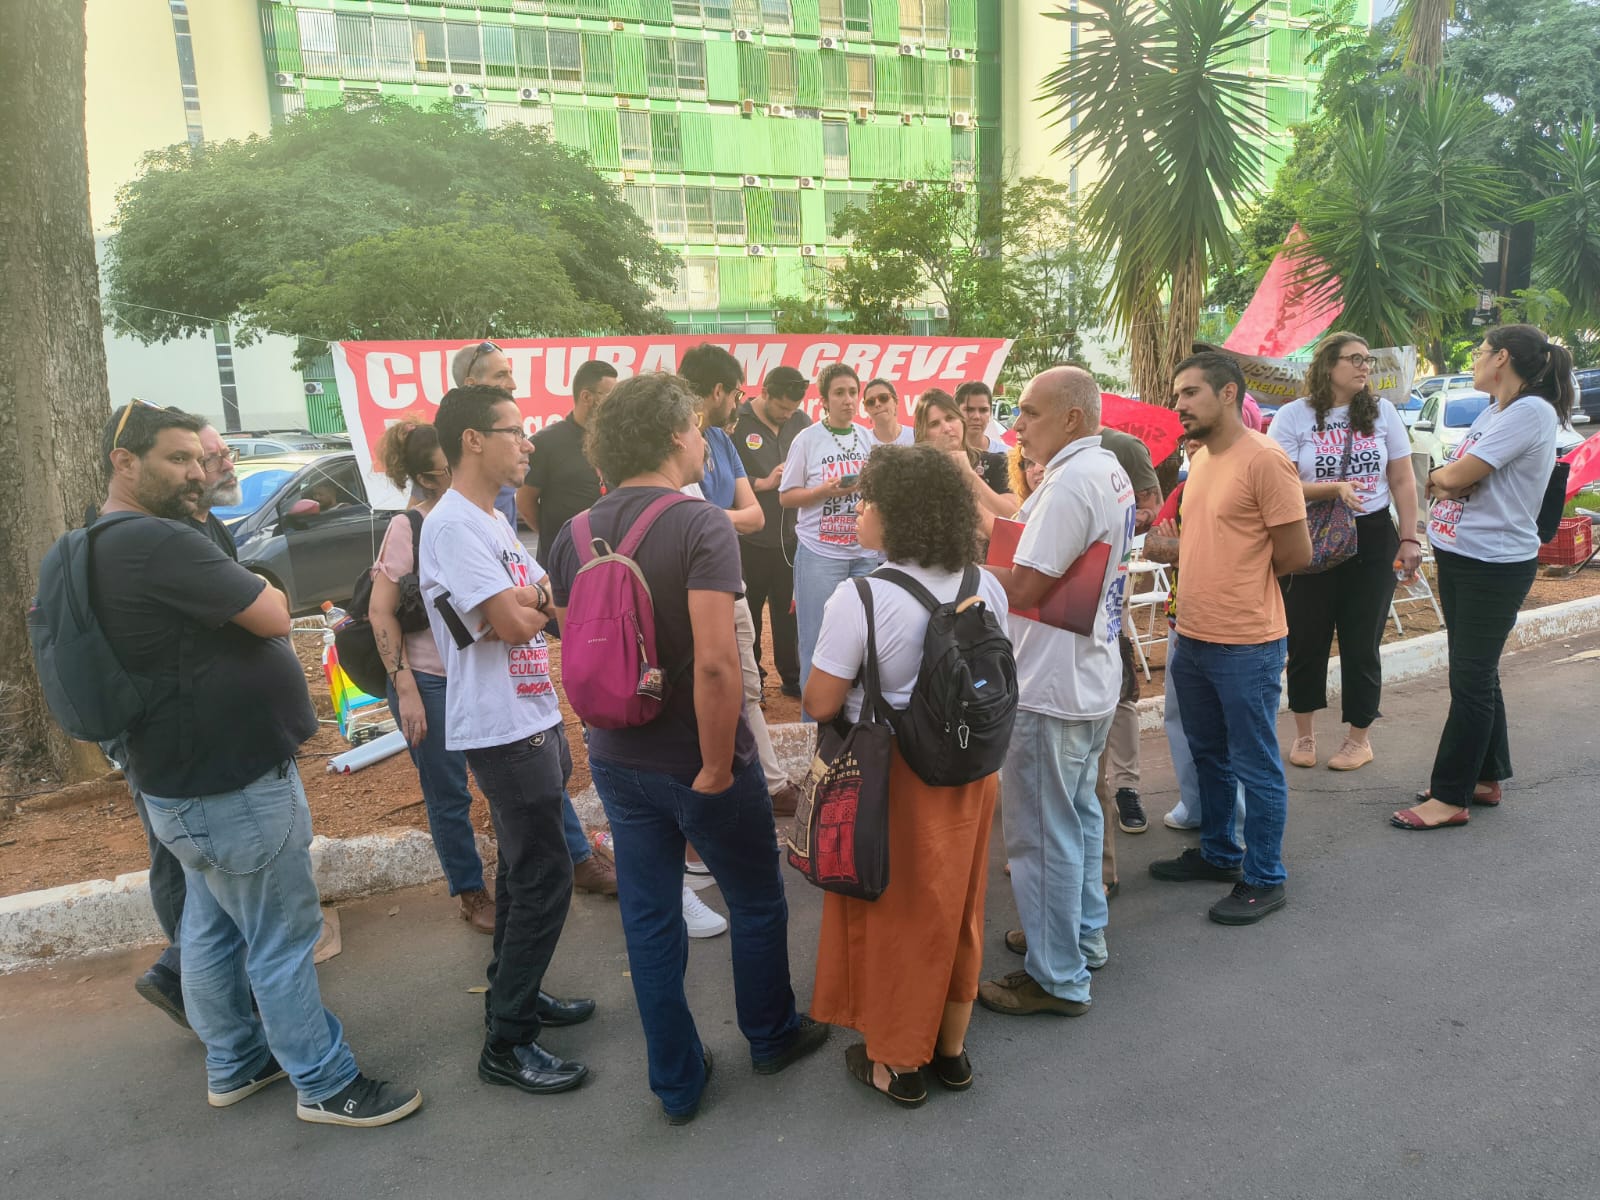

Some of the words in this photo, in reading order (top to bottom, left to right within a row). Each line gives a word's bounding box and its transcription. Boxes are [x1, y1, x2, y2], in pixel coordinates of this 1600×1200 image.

[799, 343, 980, 386] GREVE
[1377, 374, 1397, 391] JÁ!
[821, 455, 835, 465] 40
[836, 452, 861, 461] ANOS
[1315, 456, 1336, 466] 20
[1316, 467, 1335, 478] DE
